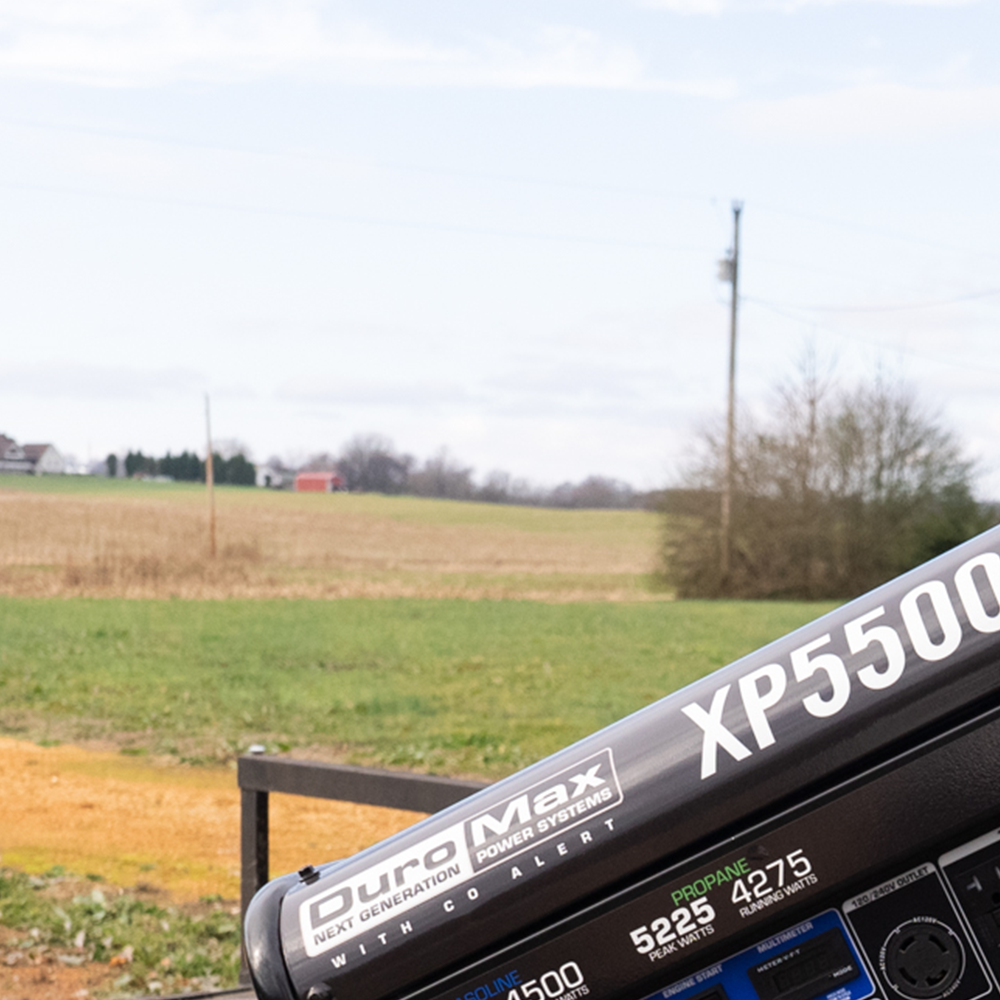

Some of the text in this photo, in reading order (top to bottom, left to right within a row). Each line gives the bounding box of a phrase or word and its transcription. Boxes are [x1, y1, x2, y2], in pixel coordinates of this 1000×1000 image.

[476, 788, 612, 864] POWER SYSTEMS
[332, 818, 614, 968] WITH CO ALERT
[671, 857, 751, 906] PROPANE
[731, 849, 812, 904] 4275
[739, 873, 818, 918] RUNNING WATTS
[851, 865, 929, 908] 120/240V OUTLET
[313, 863, 461, 946] NEXT GENERATION
[629, 896, 716, 954] 5225
[648, 924, 715, 962] PEAK WATTS
[756, 921, 813, 953] MULTIMETER
[662, 964, 724, 999] ENGINE START
